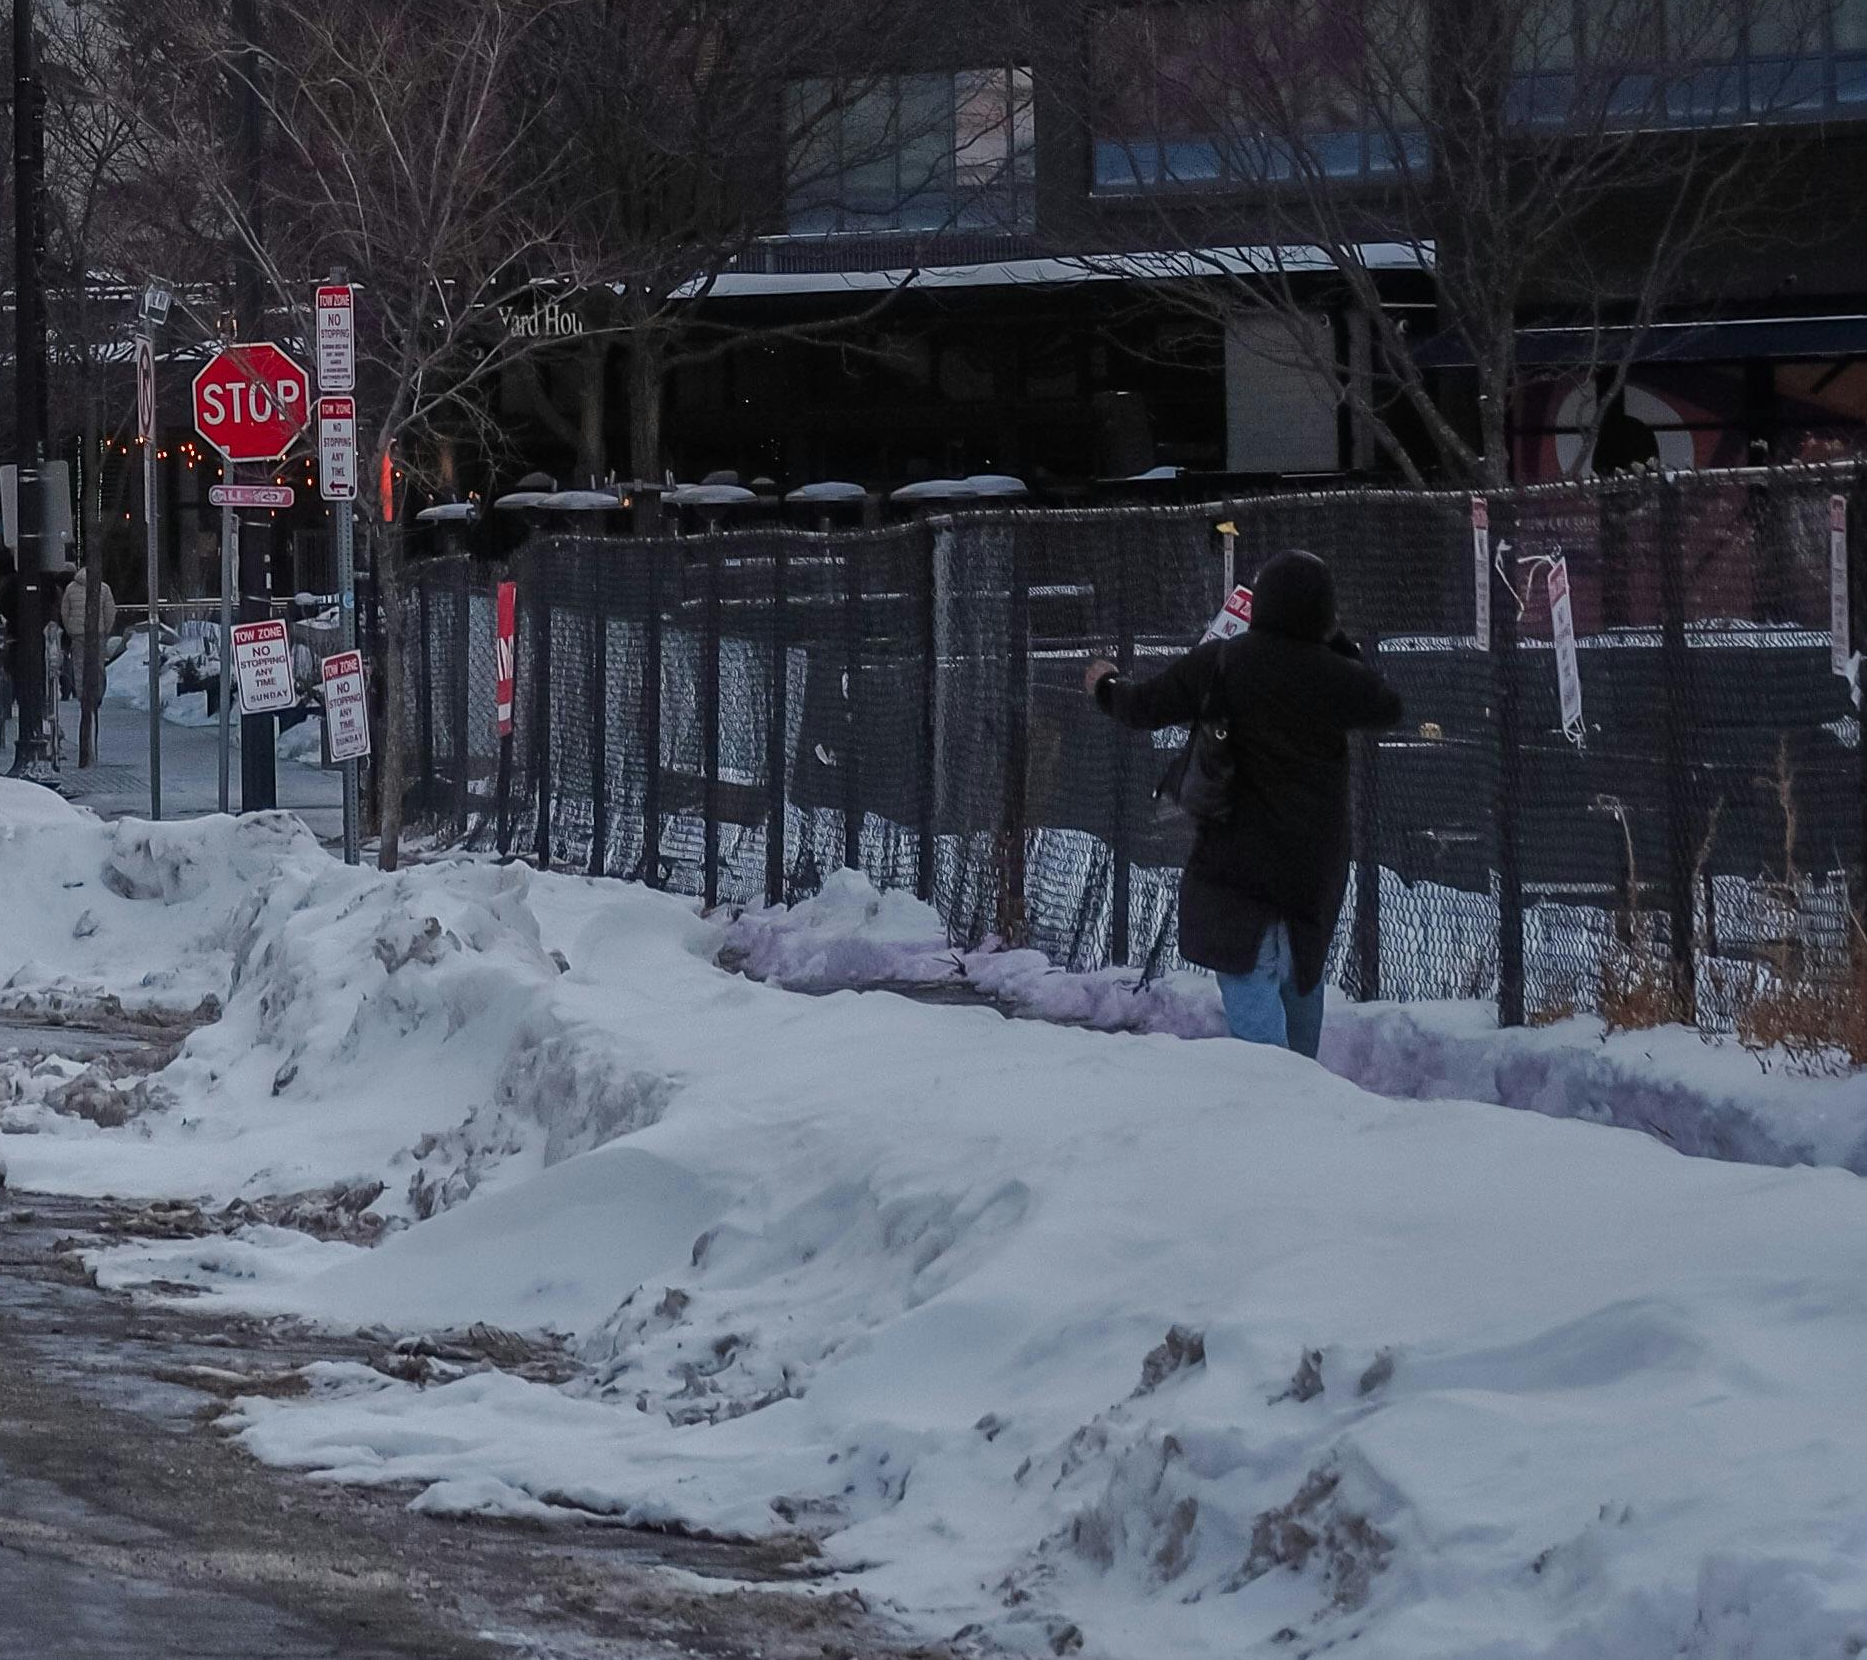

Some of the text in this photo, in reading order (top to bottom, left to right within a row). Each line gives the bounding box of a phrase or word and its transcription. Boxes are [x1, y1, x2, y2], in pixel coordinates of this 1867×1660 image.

[319, 293, 350, 307] TOW ZONE
[328, 314, 341, 326] NO
[497, 304, 583, 337] Yard Hou
[321, 329, 349, 338] STOPPING
[203, 380, 300, 425] STOP
[321, 403, 351, 415] TOW ZONE
[333, 423, 341, 432] NO
[324, 437, 351, 447] STOPPING
[332, 452, 344, 461] ANY
[332, 466, 345, 477] TIME
[235, 626, 283, 643] TOW ZONE
[252, 645, 271, 657] NO
[240, 656, 286, 669] STOPPING
[324, 659, 358, 678] TOW ZONE
[255, 668, 273, 677] ANY
[255, 678, 277, 687] TIME
[336, 682, 350, 695] NO
[250, 689, 288, 702] SUNDAY
[328, 693, 362, 708] STOPPING
[339, 708, 352, 718] ANY
[340, 720, 354, 730] TIME
[335, 734, 363, 746] SUNDAY
